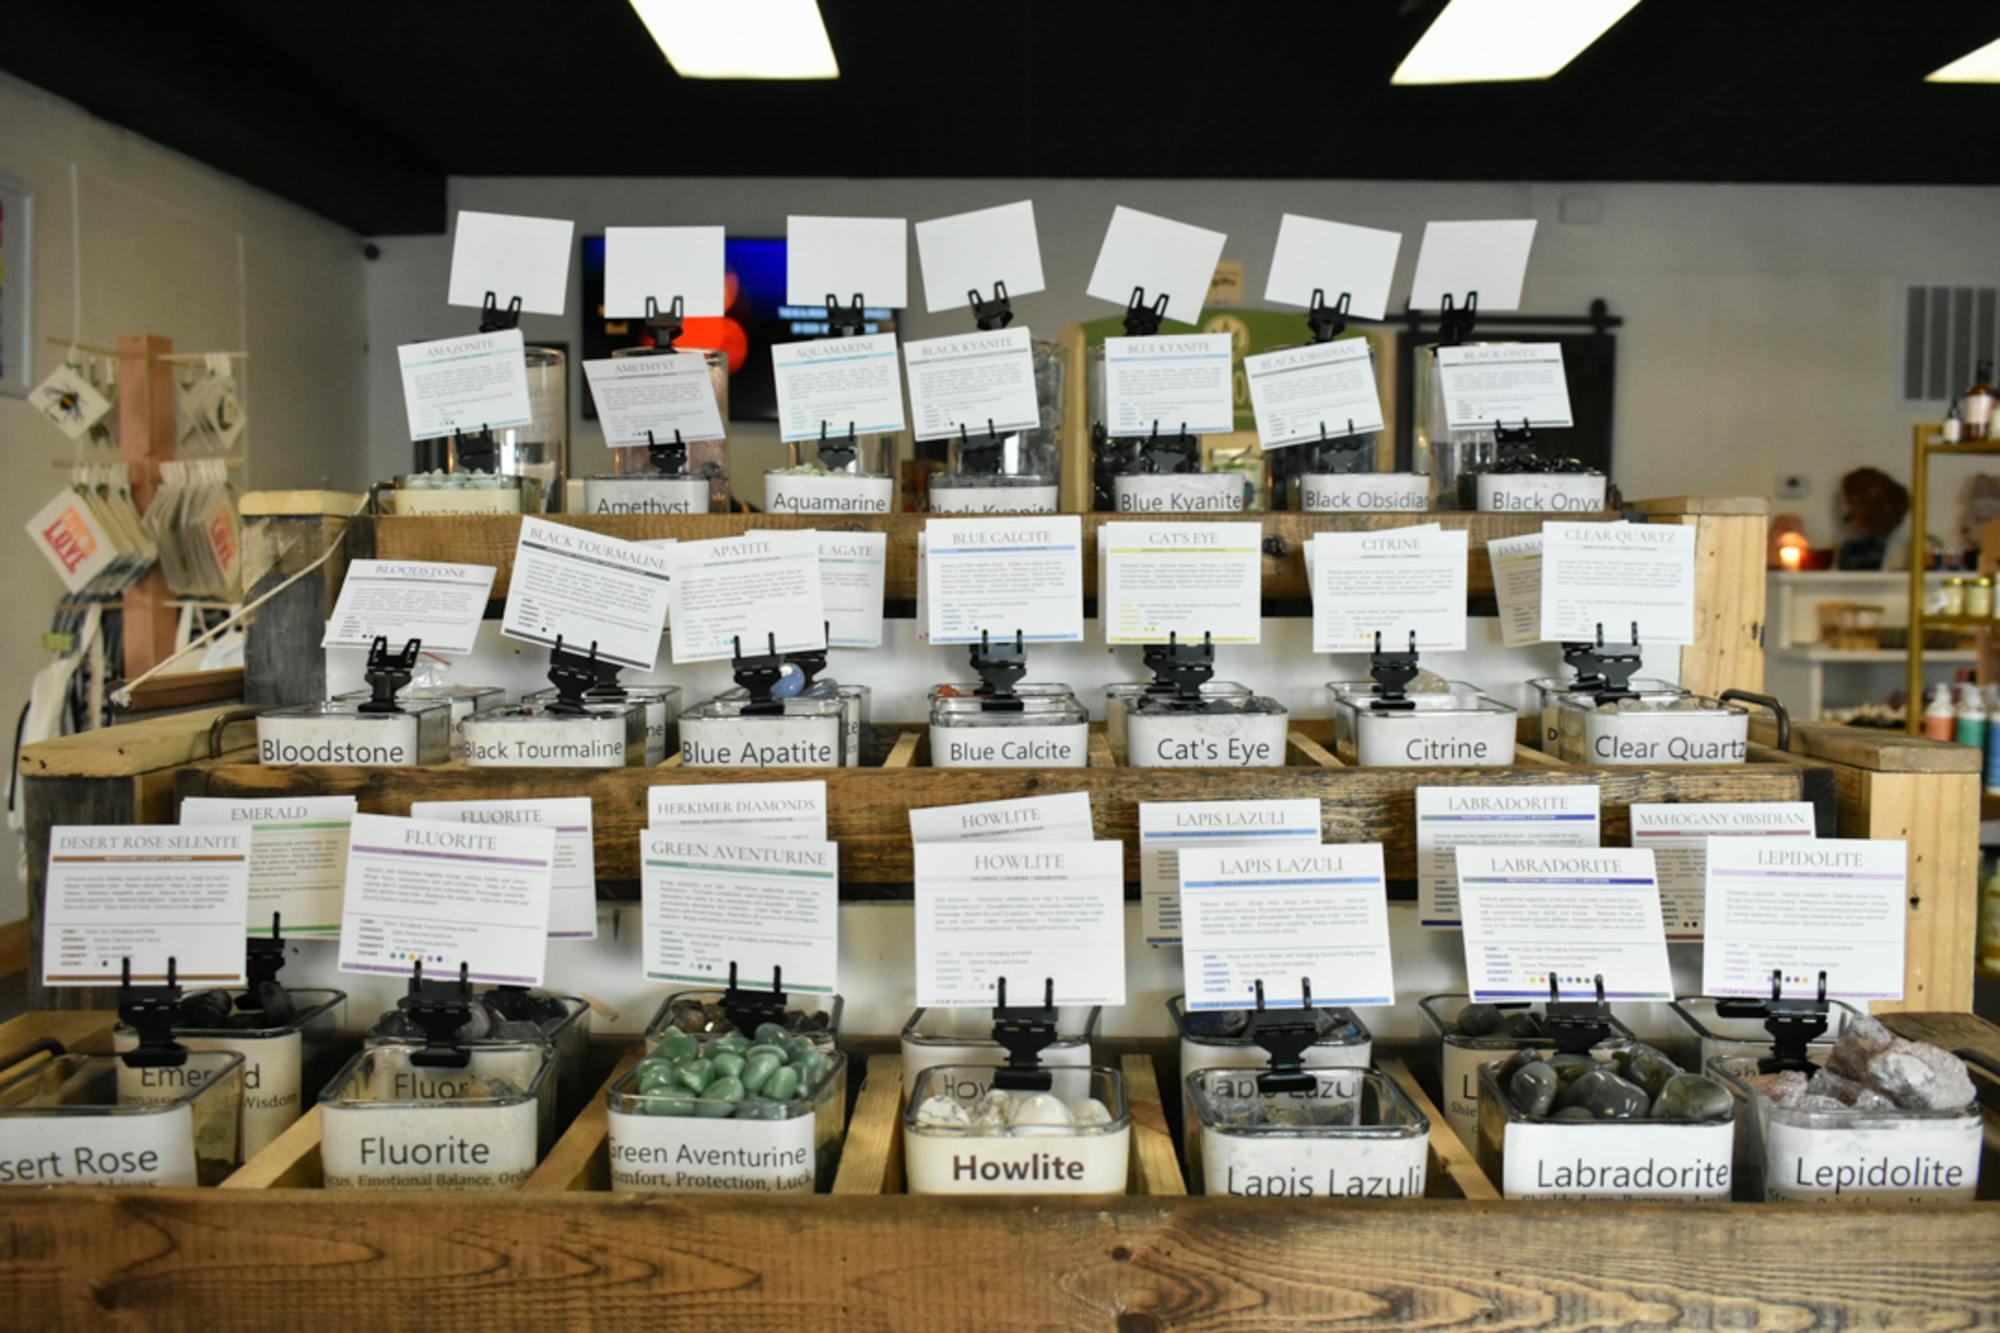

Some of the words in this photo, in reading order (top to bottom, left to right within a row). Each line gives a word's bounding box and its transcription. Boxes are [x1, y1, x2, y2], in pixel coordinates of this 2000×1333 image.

[796, 341, 876, 358] AQUAMARINE
[921, 341, 961, 356] BLACK
[963, 336, 1013, 352] KYANITE
[1127, 343, 1157, 355] BLUE
[1159, 341, 1211, 353] KYANITE
[1464, 350, 1496, 361] BLACK
[1498, 348, 1537, 360] ONYX
[1260, 354, 1298, 370] BLACK
[1299, 345, 1355, 364] OBSIDIAN
[614, 361, 676, 374] AMETHYST
[597, 497, 690, 515] Amethyst
[773, 492, 886, 514] Aquamarine
[1121, 493, 1163, 512] Blue
[1171, 491, 1242, 513] Kyanite
[1305, 491, 1351, 509] Black
[1492, 492, 1544, 510] Black
[1550, 492, 1601, 513] Onyx
[953, 531, 988, 545] BLUE
[990, 530, 1052, 544] CALCITE
[1149, 532, 1190, 545] CAT'S
[1192, 532, 1219, 545] EYE
[1361, 538, 1422, 551] CITRINE
[1564, 527, 1612, 543] CLEAR
[1614, 529, 1676, 545] QUARTZ
[530, 527, 575, 551] BLACK
[576, 538, 667, 570] TOURMALINE
[711, 541, 773, 559] APATITE
[830, 545, 873, 557] AGATE
[376, 564, 467, 579] BLOODSTONE
[262, 739, 405, 764] Bloodstone
[465, 739, 508, 760] Black
[516, 738, 623, 760] Tourmaline
[682, 740, 731, 764] Blue
[740, 739, 832, 768] Apatite
[950, 741, 994, 762] Blue
[1002, 740, 1072, 761] Calcite
[1157, 737, 1219, 761] Cat's
[1228, 737, 1270, 766] Eye
[1405, 737, 1488, 760] Citrine
[1595, 735, 1659, 759] Clear
[657, 801, 733, 816] HERKIMER
[736, 799, 817, 814] DIAMONDS
[1448, 796, 1569, 811] LABRADORITE
[231, 806, 309, 822] EMERALD
[461, 808, 543, 825] FLUORITE
[961, 807, 1041, 829] HOWLITE
[1176, 811, 1222, 827] LAPIS
[1226, 811, 1286, 826] LAZULI
[1639, 812, 1735, 826] MAHOGANY
[1736, 812, 1806, 825] OBSIDIAN
[60, 836, 121, 850] DESERT
[123, 836, 165, 849] ROSE
[167, 835, 241, 849] SELENITE
[404, 828, 498, 852] FLUORITE
[651, 841, 710, 857] GREEN
[713, 844, 828, 867] AVENTURINE
[975, 853, 1066, 870] HOWLITE
[1758, 850, 1864, 868] LEPIDOLITE
[1219, 858, 1272, 875] LAPIS
[1276, 857, 1344, 873] LAZULI
[1491, 857, 1624, 873] LABRADORITE
[142, 1063, 261, 1090] Emerd
[361, 1136, 490, 1165] Fluorite
[676, 1143, 808, 1168] Aventurine
[0, 1150, 63, 1182] sert
[75, 1147, 159, 1175] Rose
[953, 1152, 1085, 1181] Howlite
[1538, 1158, 1729, 1188] Labradorite
[358, 1172, 432, 1187] Emotional
[436, 1172, 496, 1188] Balance,
[612, 1169, 672, 1188] omfort,
[677, 1171, 772, 1192] Protection,
[1228, 1166, 1315, 1197] Lapis
[1329, 1165, 1422, 1197] Lazuli
[1796, 1157, 1963, 1194] Lepidolite
